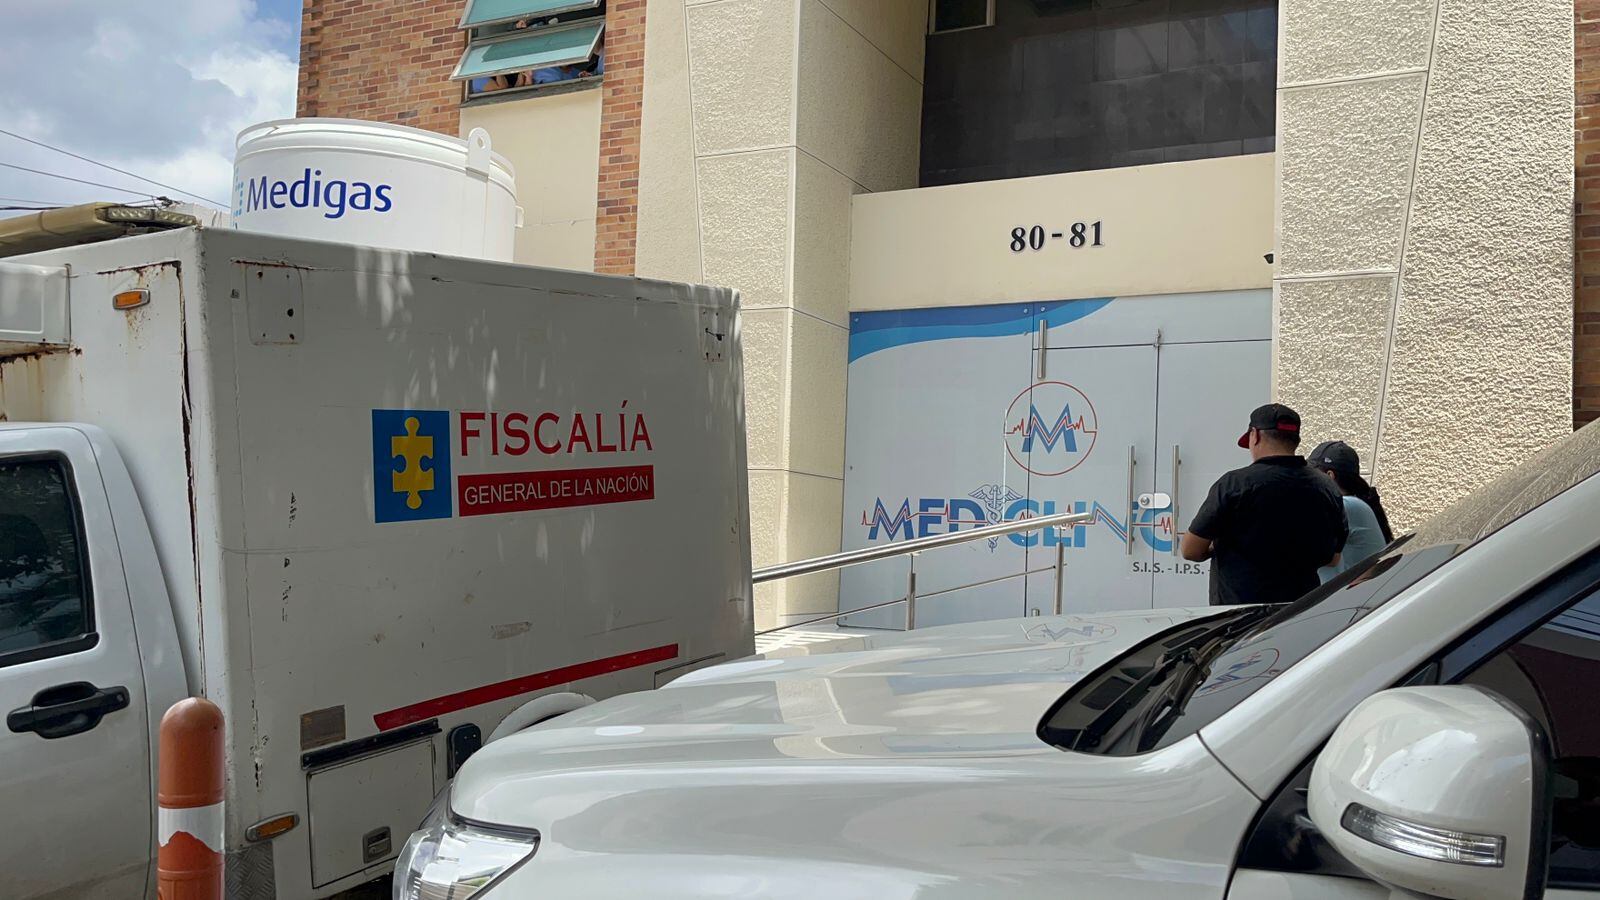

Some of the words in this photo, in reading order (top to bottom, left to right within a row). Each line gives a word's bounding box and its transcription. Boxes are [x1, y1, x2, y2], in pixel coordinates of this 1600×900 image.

[246, 168, 392, 219] Medigas
[459, 400, 653, 457] FISCALÍA
[464, 480, 547, 506] GENERAL
[550, 479, 572, 498] DE
[575, 478, 594, 496] LA
[596, 472, 649, 495] NACIÓN
